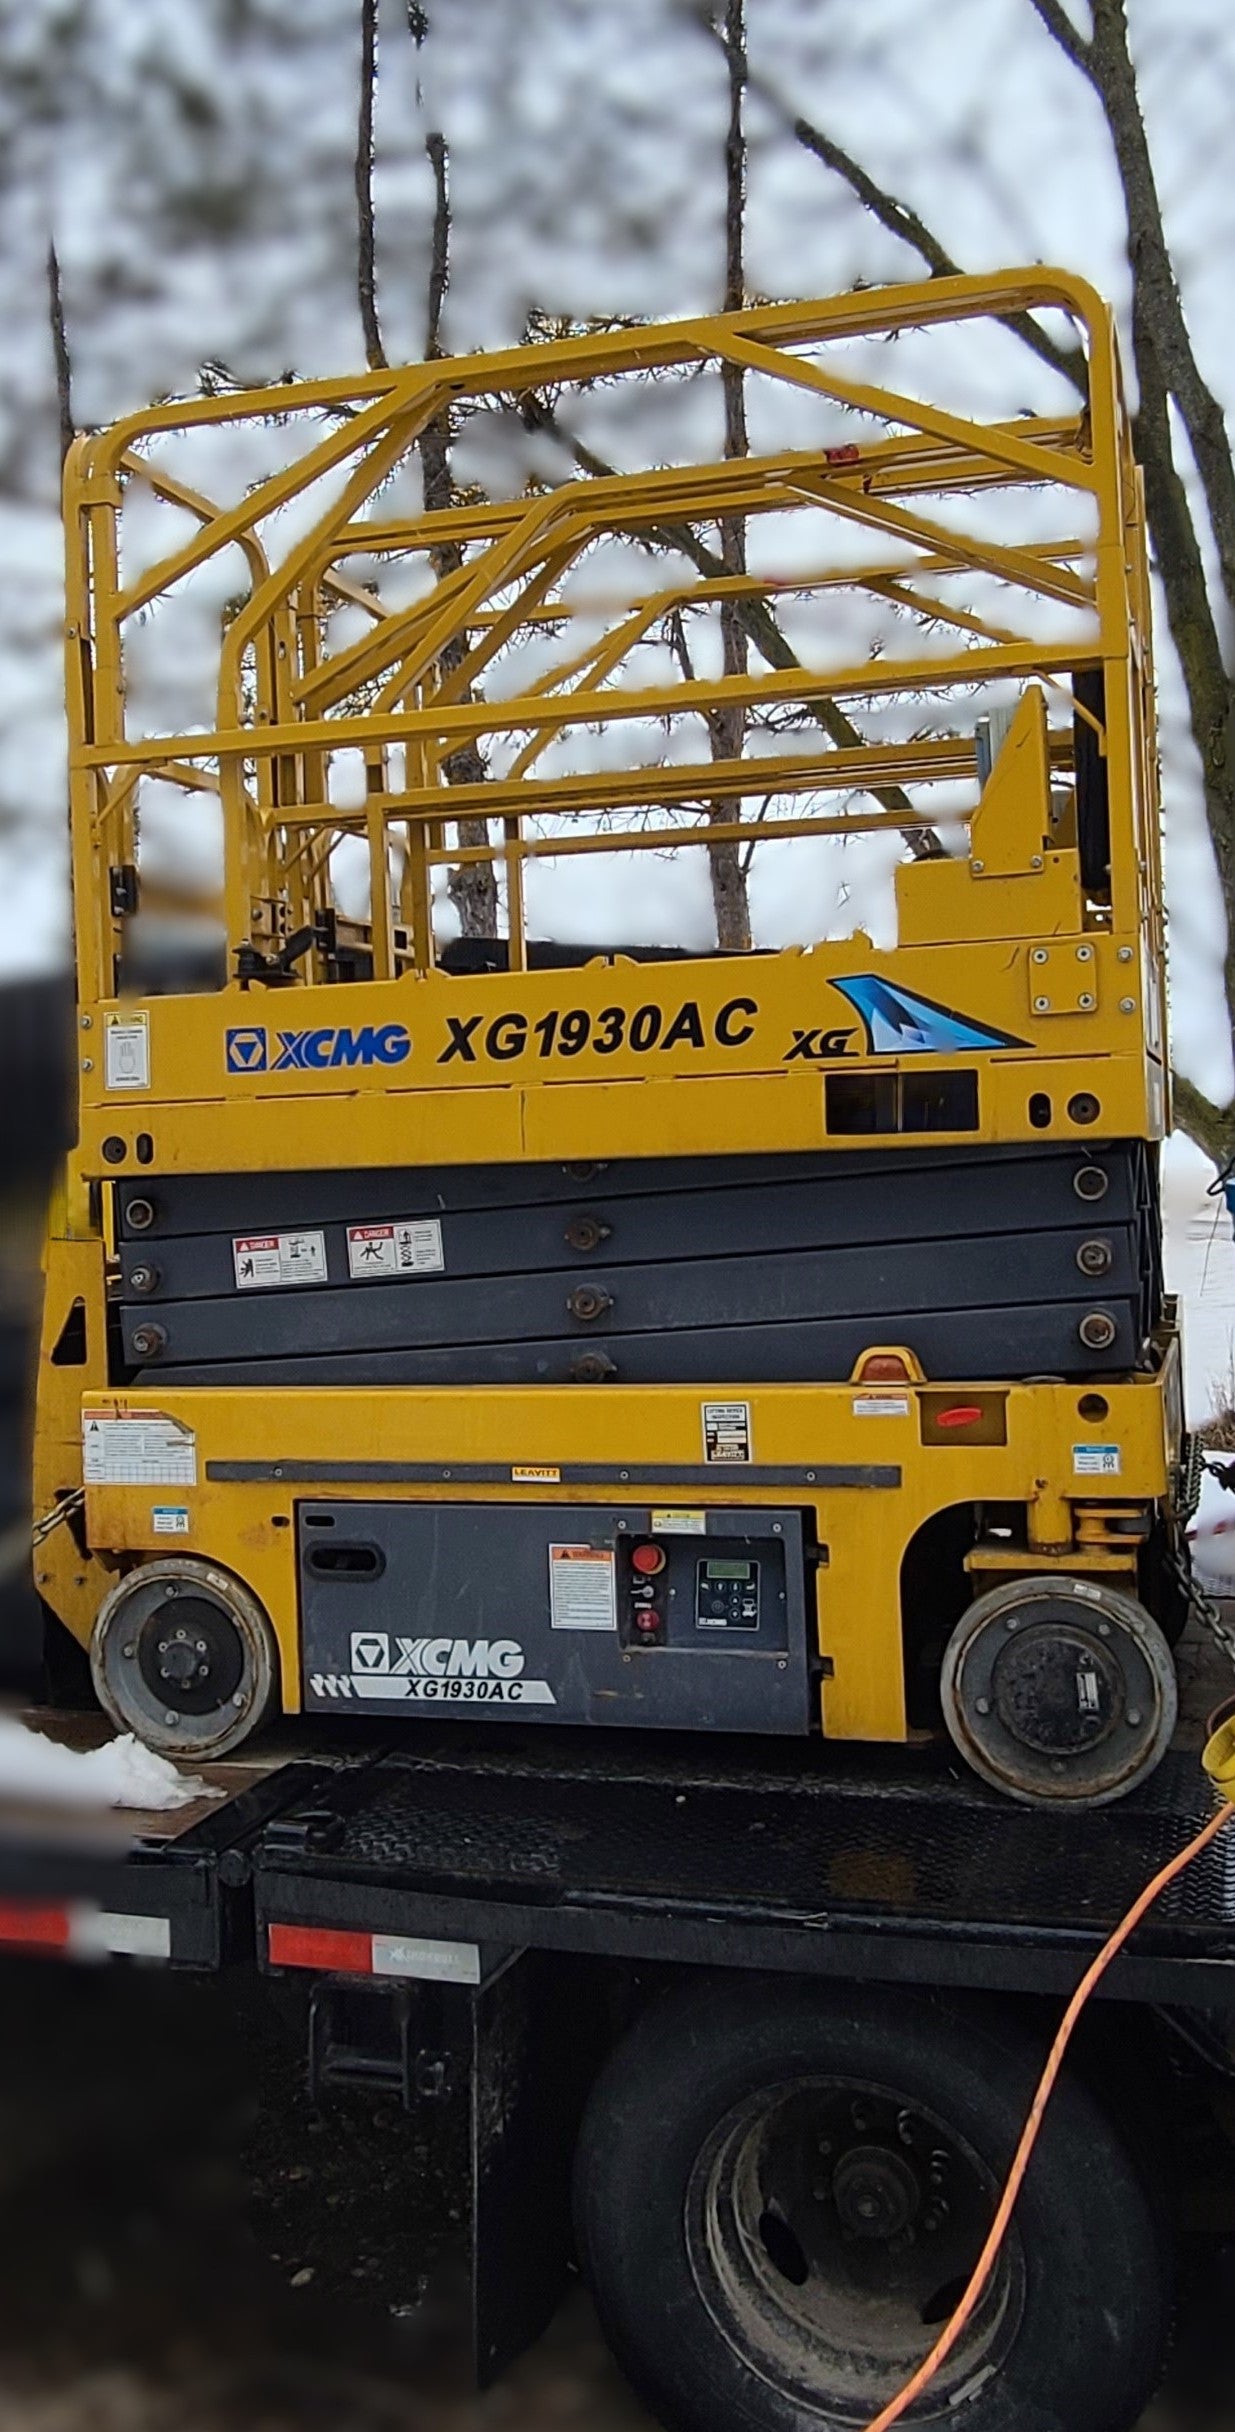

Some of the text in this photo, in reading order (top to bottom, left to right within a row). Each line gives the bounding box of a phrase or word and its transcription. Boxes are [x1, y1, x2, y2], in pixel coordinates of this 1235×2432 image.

[269, 997, 861, 1072] XCMG XG1930AC XG
[513, 1467, 558, 1477] LEAVITT
[389, 1636, 525, 1679] XCMG
[404, 1678, 524, 1700] XG1930AC
